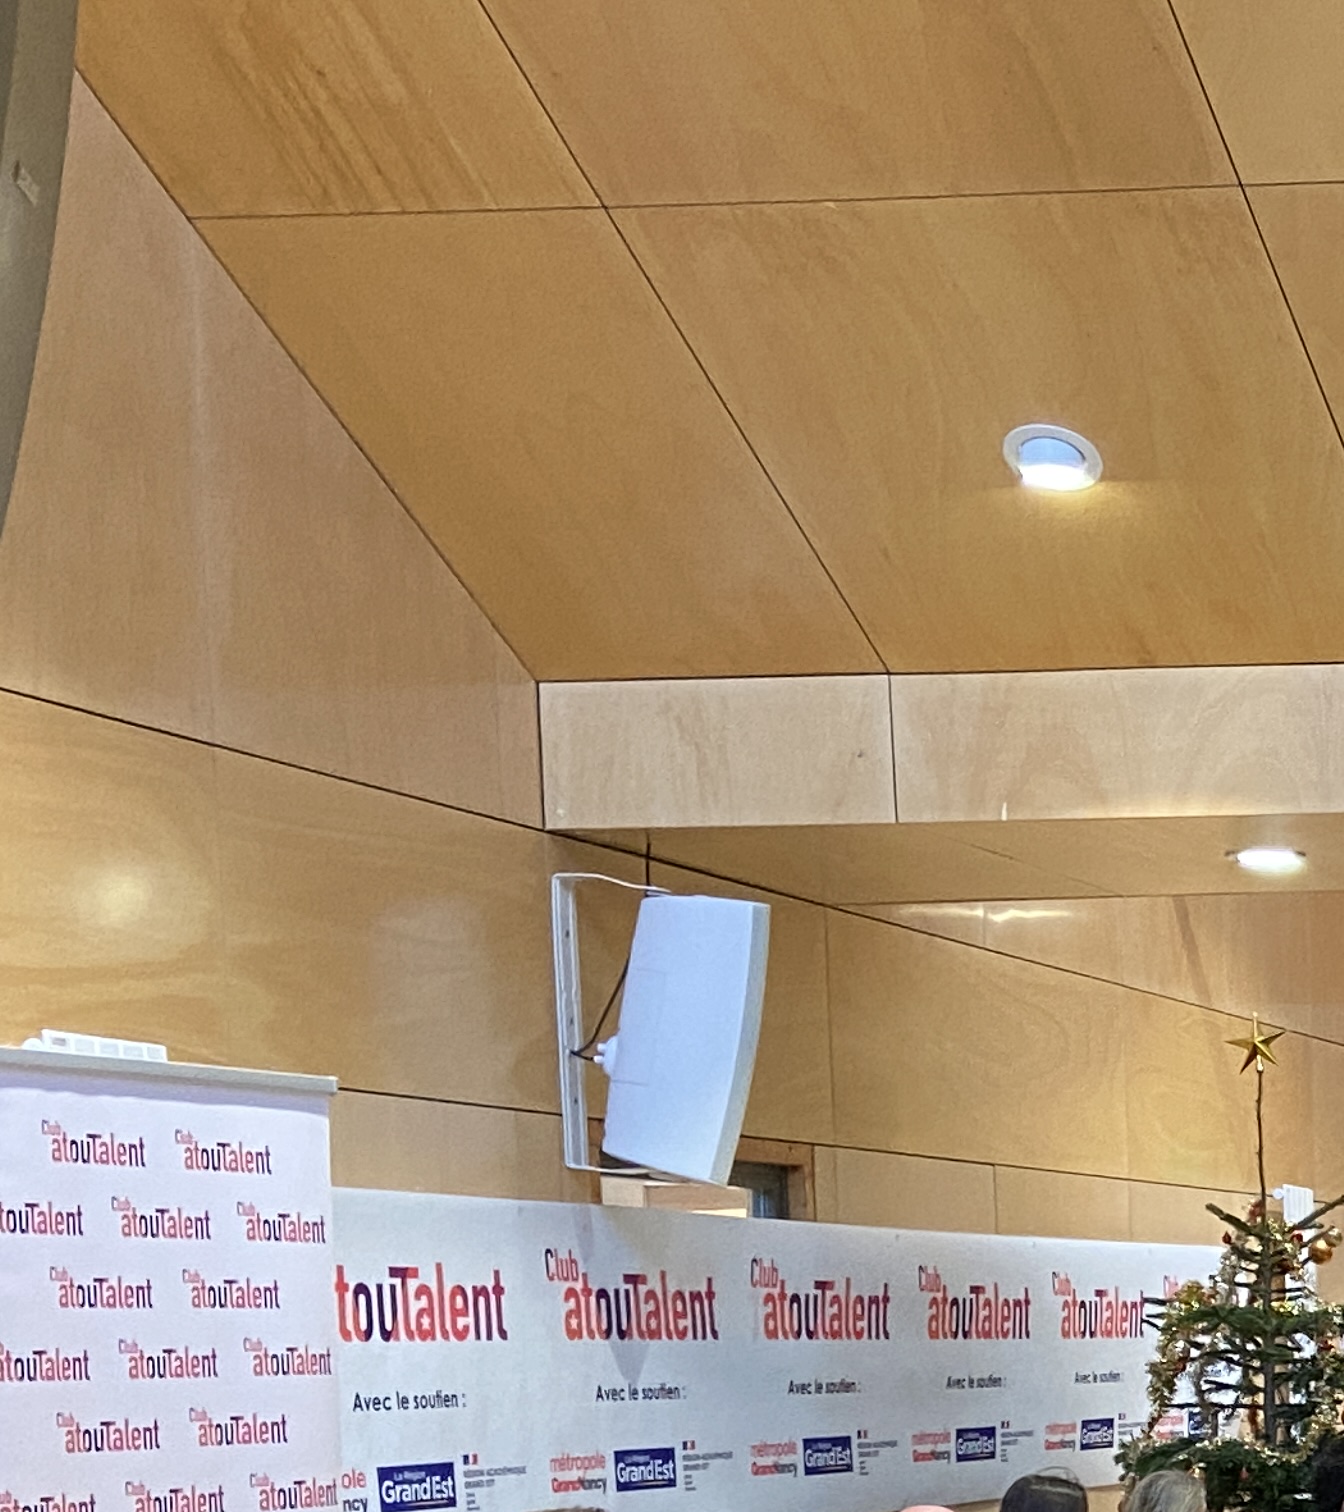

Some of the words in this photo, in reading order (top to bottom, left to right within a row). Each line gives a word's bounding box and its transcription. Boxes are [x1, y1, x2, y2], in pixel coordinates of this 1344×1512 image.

[51, 1133, 146, 1167] atouTalent
[184, 1141, 272, 1175] atouTalent
[121, 1207, 211, 1240] atouTalent
[246, 1212, 326, 1244] atouTalent
[545, 1249, 579, 1282] Club
[750, 1257, 779, 1288] Club
[58, 1275, 153, 1309] atouTalent
[191, 1277, 280, 1309] atouTalent
[563, 1270, 719, 1340] atouTalent
[763, 1277, 890, 1340] atouTalent
[928, 1282, 1031, 1340] atouTalent
[1061, 1286, 1145, 1338] atouTalent
[128, 1346, 218, 1379] atouTalent
[253, 1345, 332, 1376] atouTalent
[353, 1392, 391, 1412] Avec
[396, 1390, 410, 1410] le
[414, 1389, 458, 1410] soutien
[595, 1385, 626, 1402] Avec
[628, 1385, 639, 1400] le
[642, 1382, 681, 1399] soutien
[788, 1380, 813, 1395] Avec
[815, 1379, 824, 1394] le
[65, 1418, 160, 1453] atouTalent
[198, 1413, 288, 1447] atouTalent
[259, 1477, 339, 1512] atouTalent
